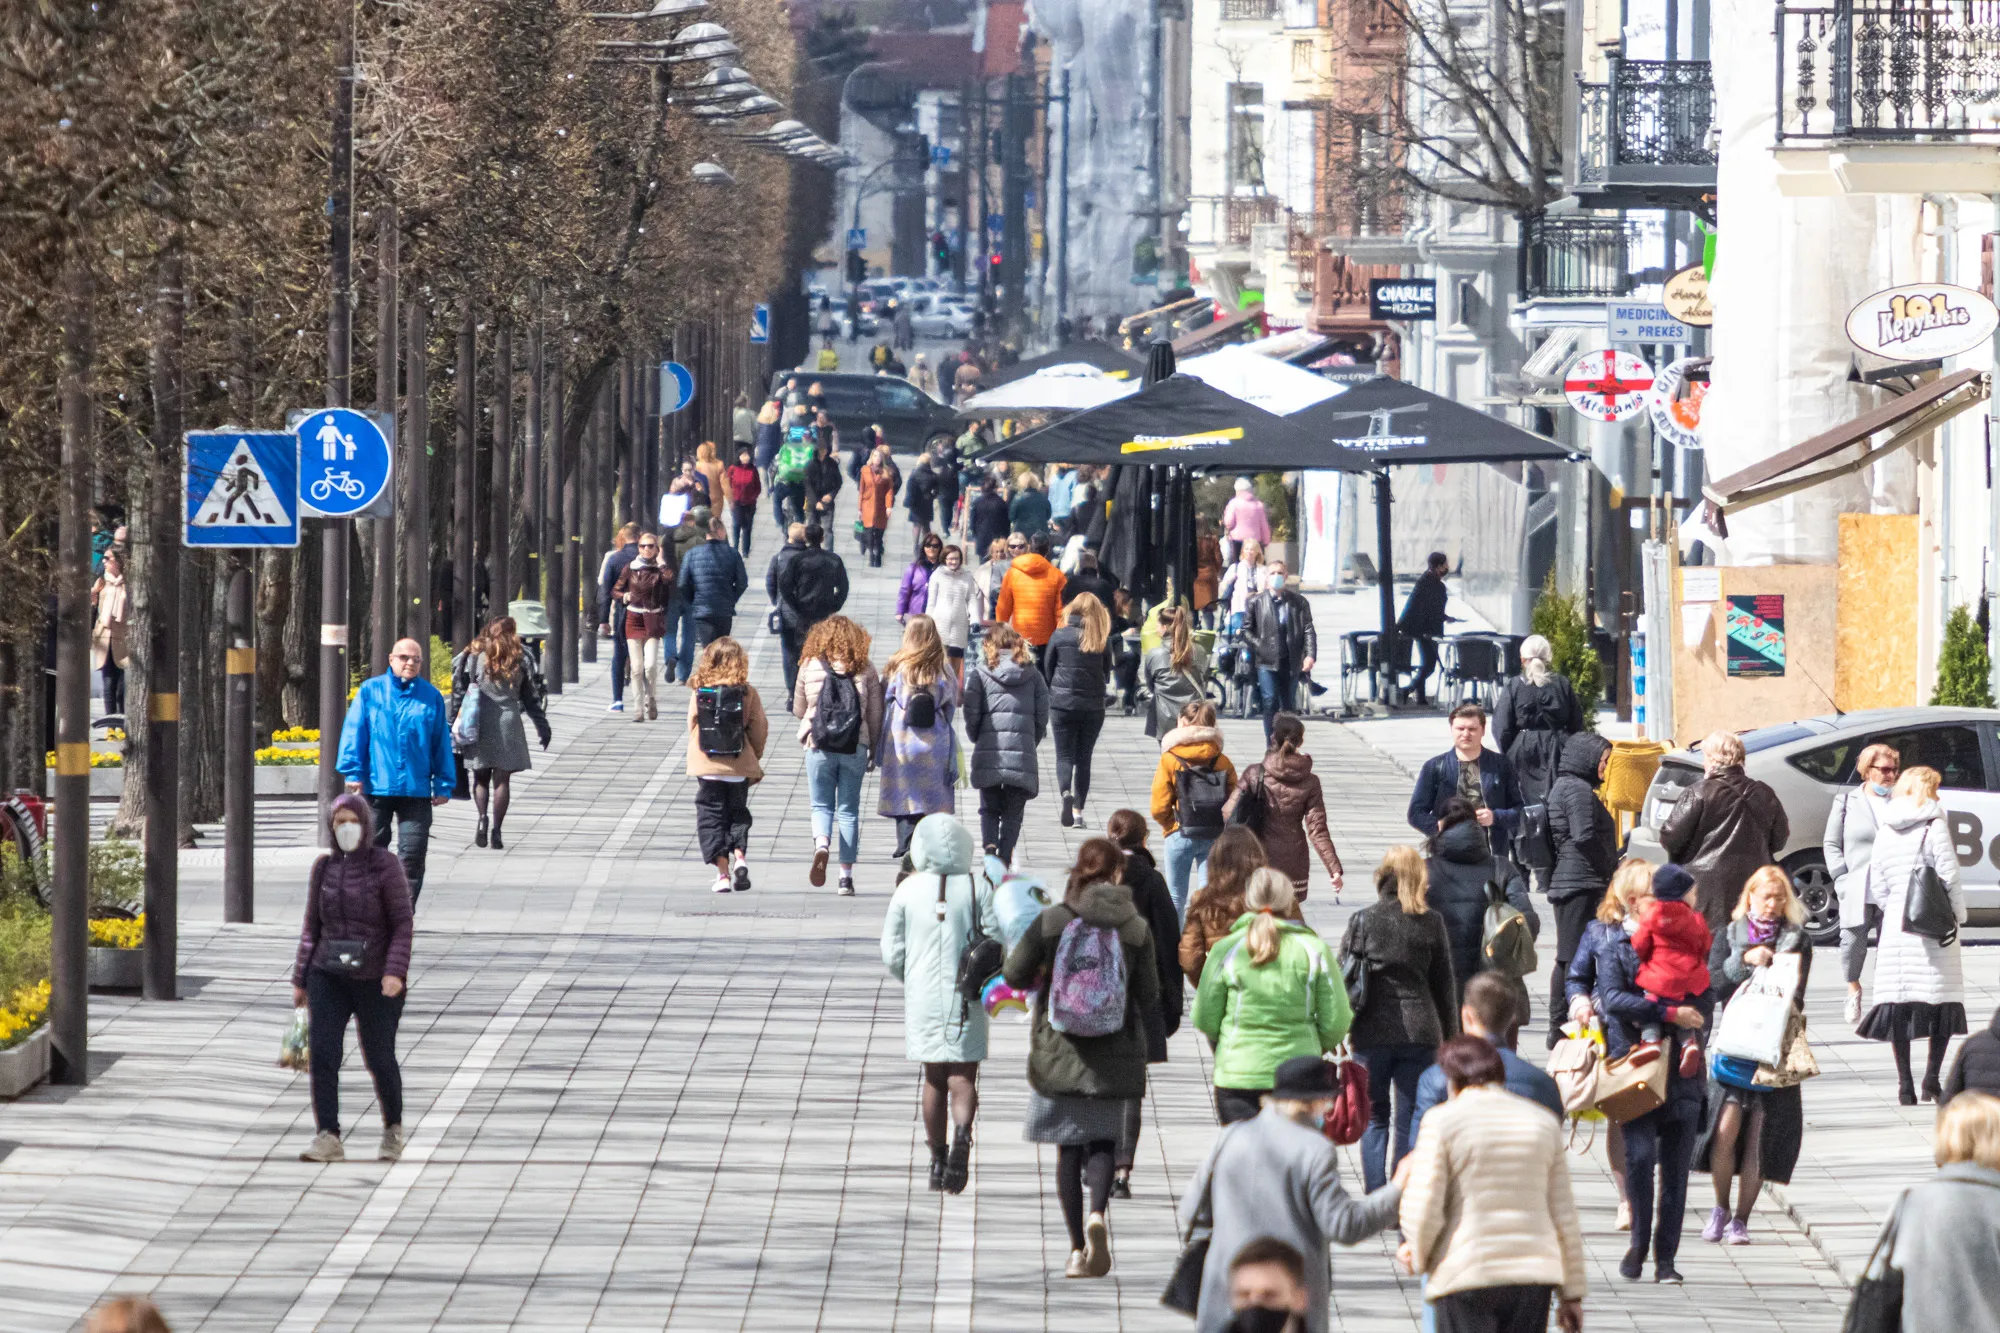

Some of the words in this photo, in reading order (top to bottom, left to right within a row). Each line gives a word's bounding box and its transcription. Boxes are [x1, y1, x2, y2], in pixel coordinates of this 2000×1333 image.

[1377, 285, 1433, 302] CHARLIE
[1392, 302, 1419, 314] PIZZA
[1616, 308, 1675, 320] MEDICIN
[1889, 293, 1947, 322] 101
[1638, 324, 1683, 337] PREKĖS
